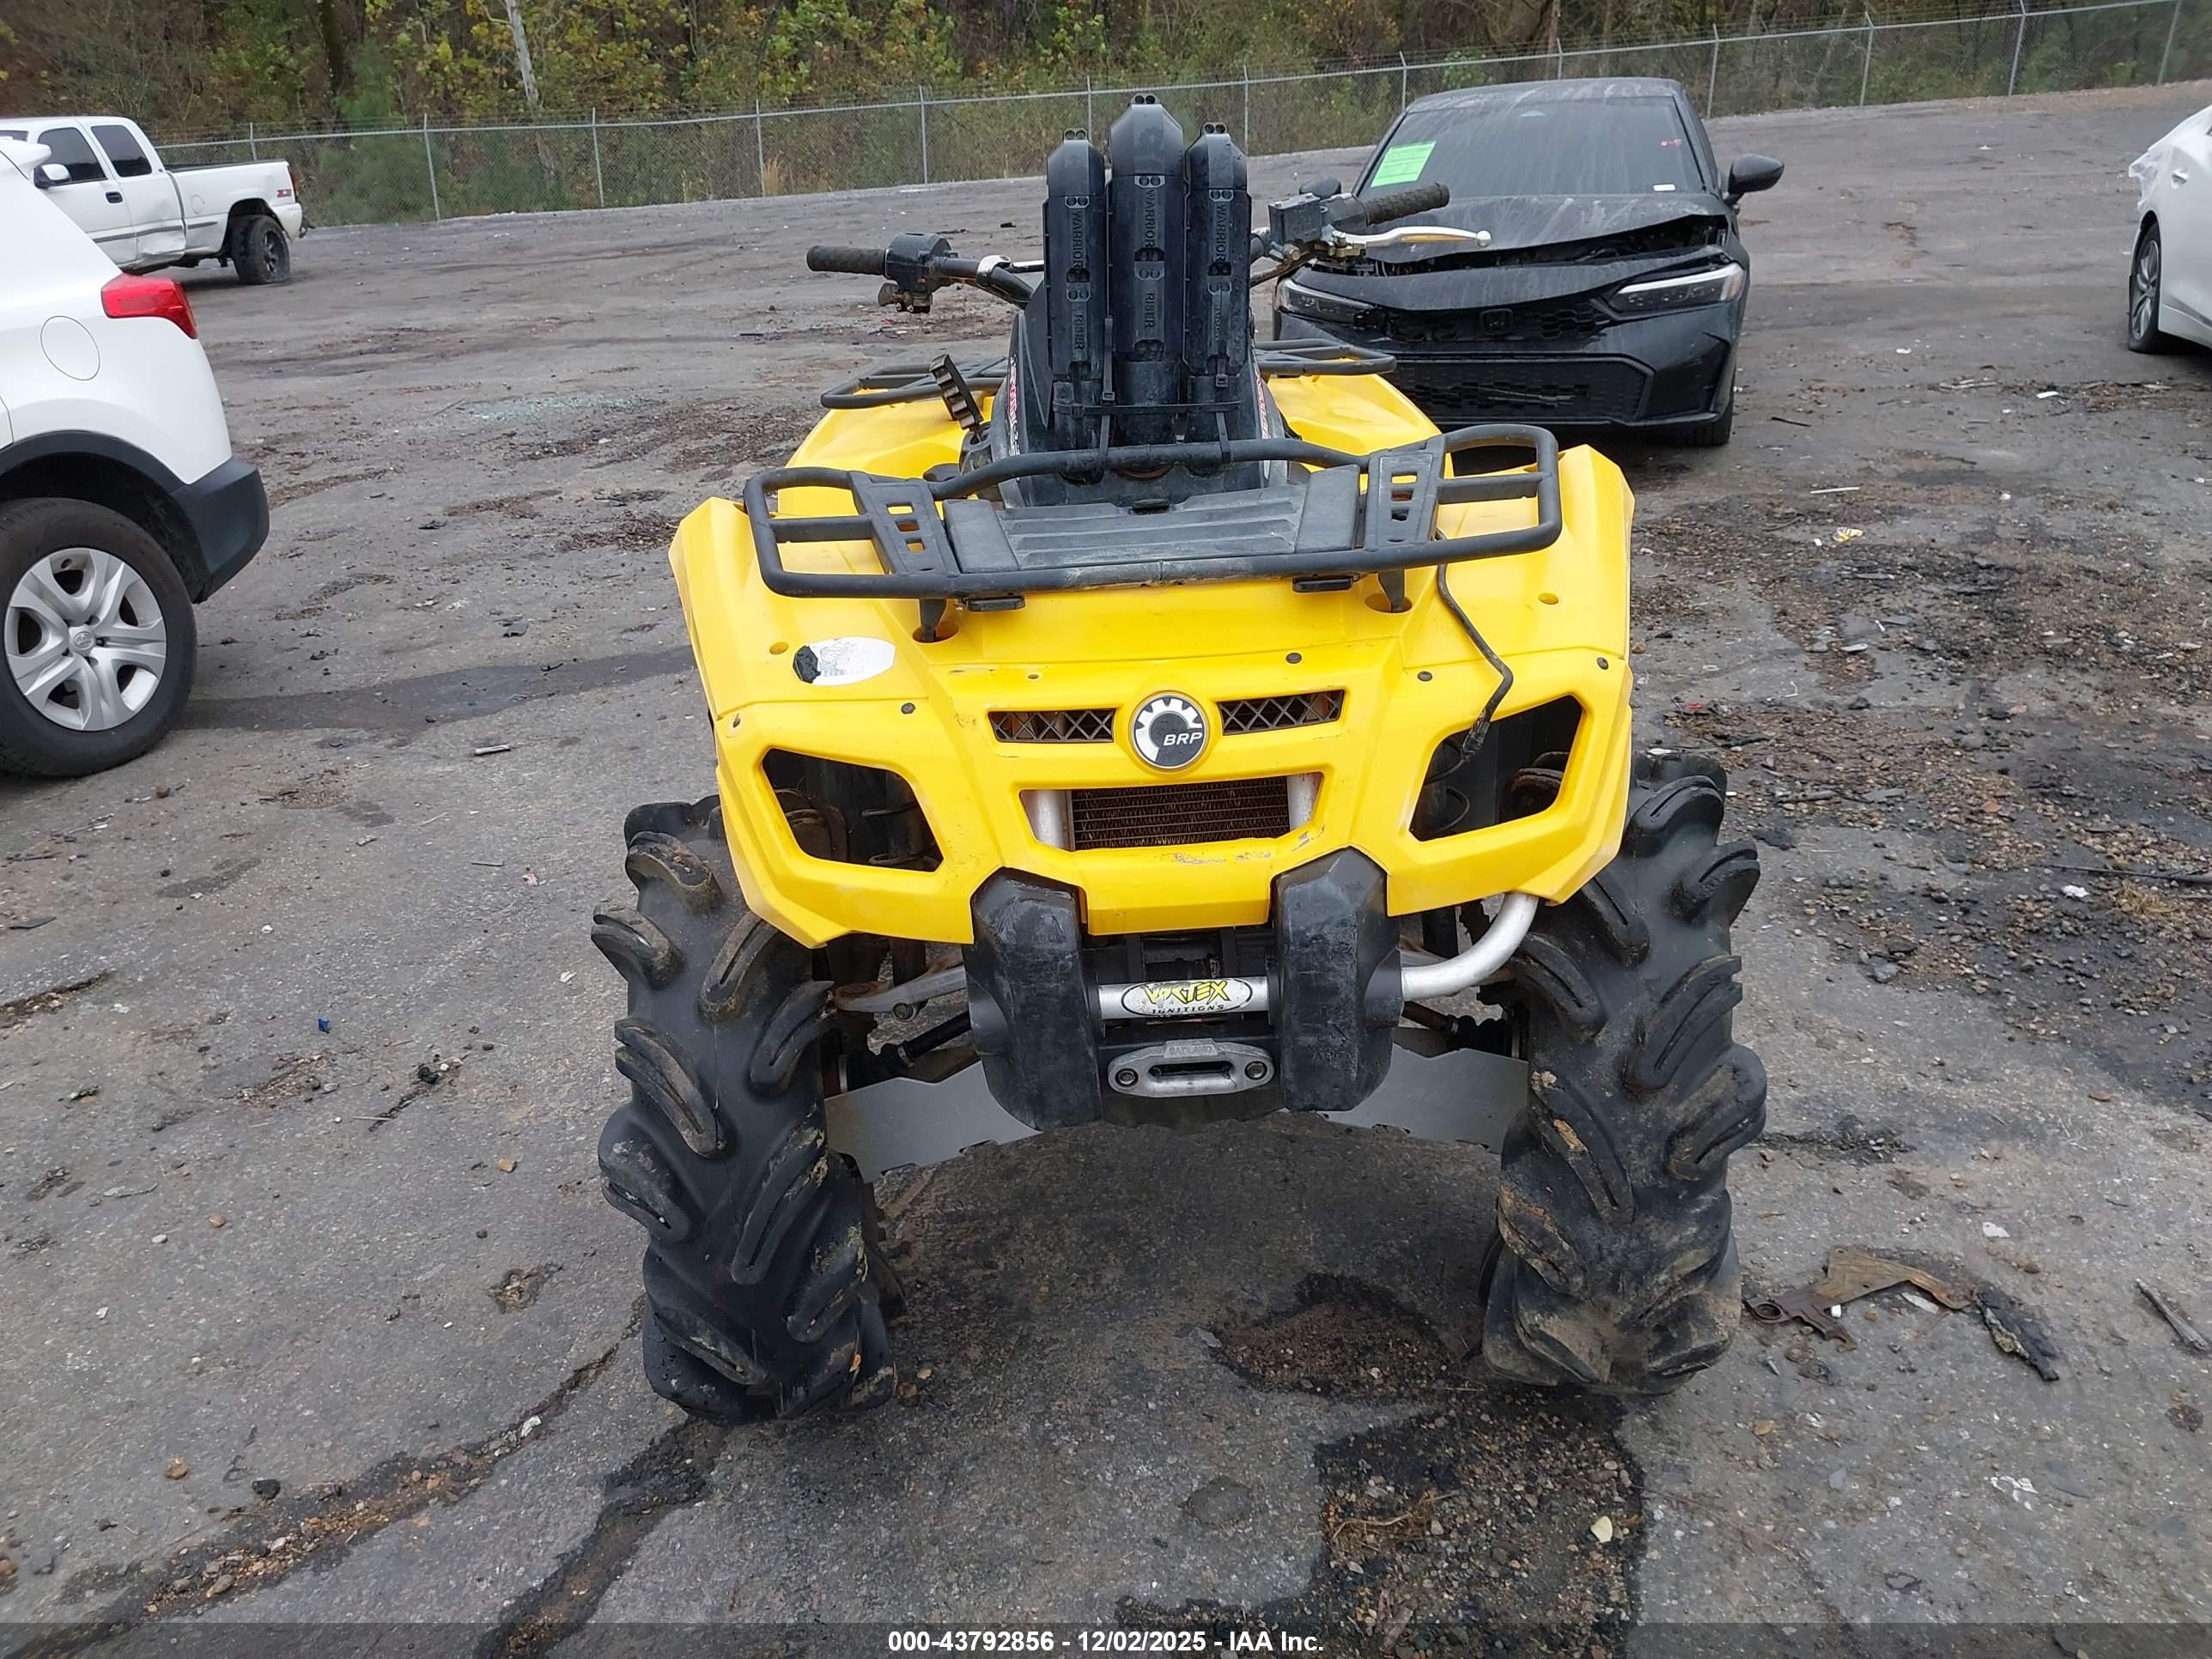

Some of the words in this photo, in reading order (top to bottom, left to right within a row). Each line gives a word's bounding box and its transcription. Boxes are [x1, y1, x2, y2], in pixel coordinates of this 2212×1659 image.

[1145, 189, 1155, 247] WARRIOR
[1216, 204, 1227, 262] WARRIOR
[1073, 210, 1084, 269] WARRIOR
[1145, 292, 1155, 328] RISER
[1074, 314, 1085, 350] RISER
[1163, 732, 1203, 746] BRP
[1152, 1004, 1224, 1014] IGNITIONS
